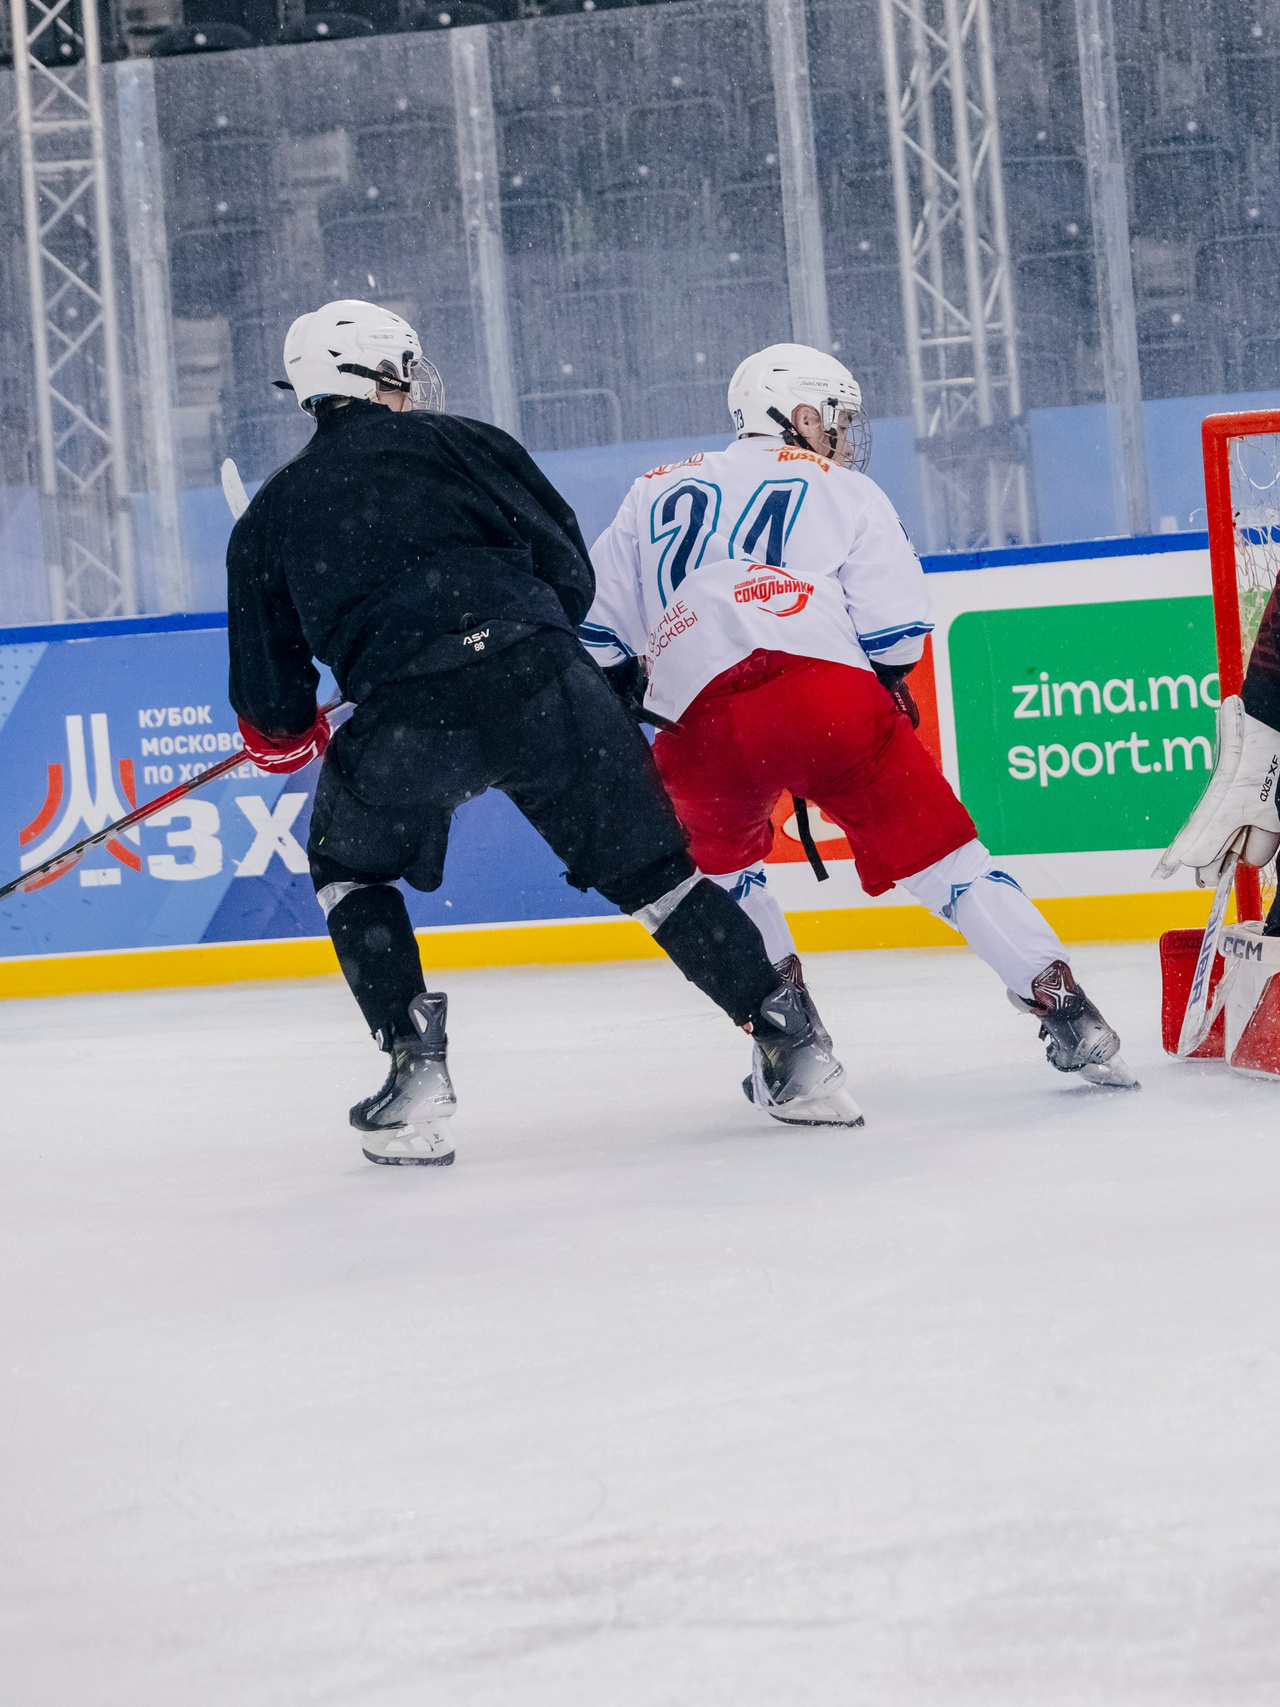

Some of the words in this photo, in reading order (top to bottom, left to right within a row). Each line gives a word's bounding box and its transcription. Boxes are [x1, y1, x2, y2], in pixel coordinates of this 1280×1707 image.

[777, 449, 831, 474] Russia
[733, 579, 815, 603] СОКОЛЬНИКИ
[138, 705, 213, 728] КУБОК
[144, 763, 174, 785] ПО
[1268, 754, 1279, 776] XF
[1222, 935, 1264, 962] CCM
